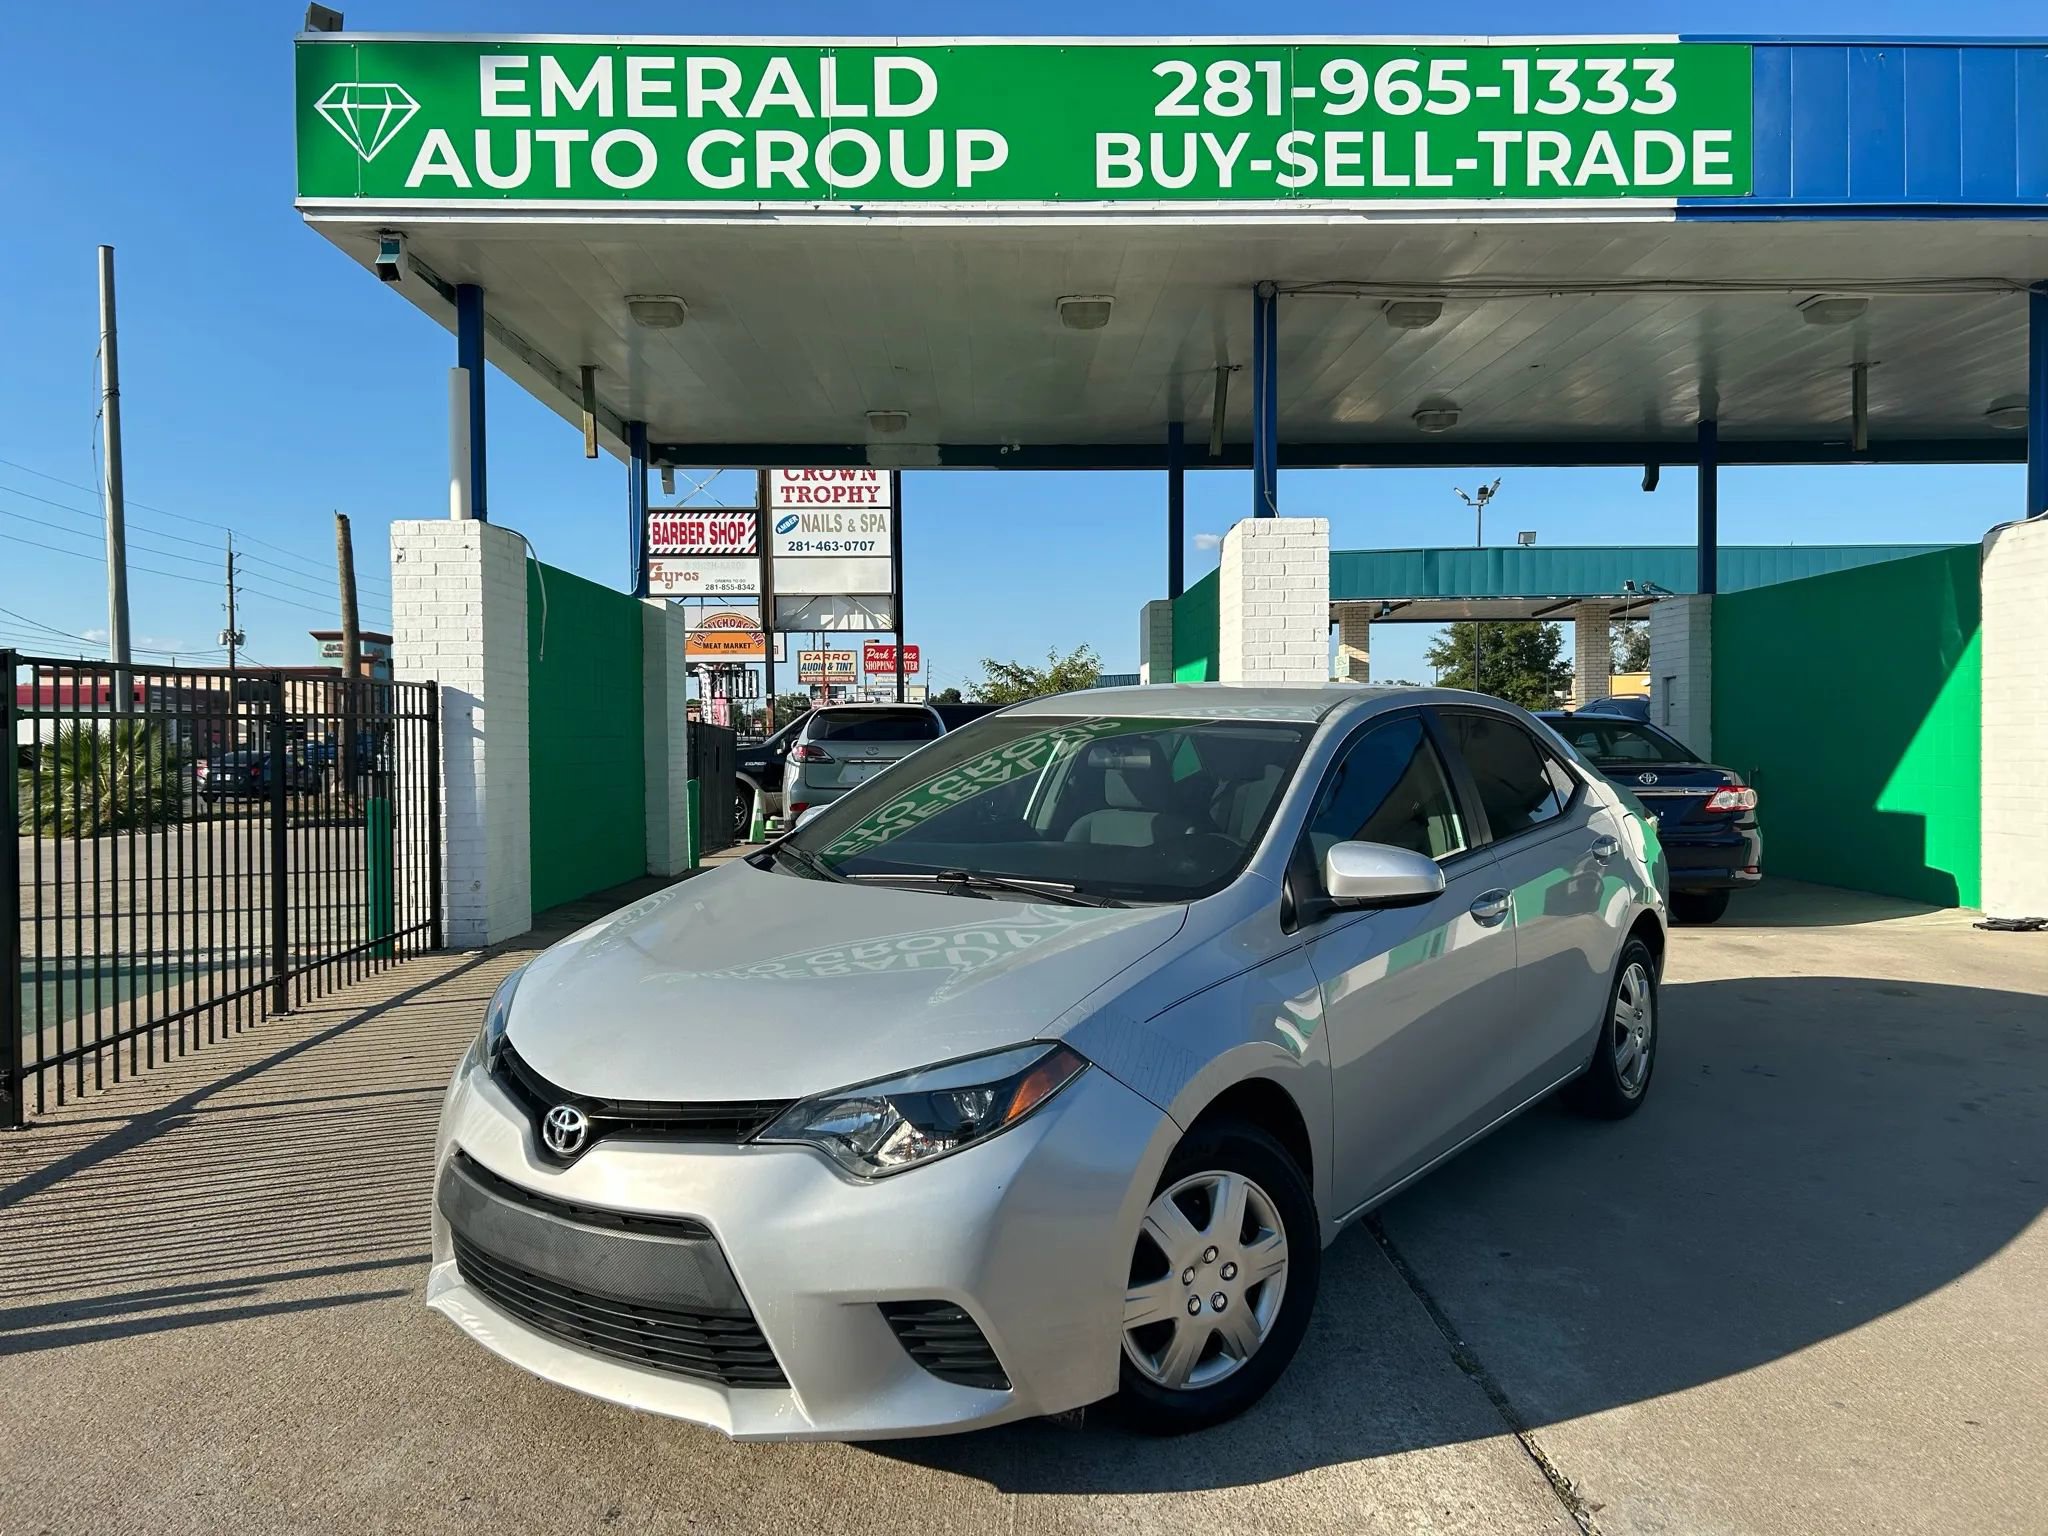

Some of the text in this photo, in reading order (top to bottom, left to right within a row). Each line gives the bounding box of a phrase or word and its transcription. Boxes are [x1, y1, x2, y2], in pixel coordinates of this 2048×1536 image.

[480, 55, 938, 118] EMERALD
[1151, 58, 1677, 117] 281-965-1333
[405, 128, 1010, 189] AUTO GROUP
[1095, 130, 1733, 189] BUY-SELL-TRADE
[783, 468, 877, 481] CROWN
[781, 486, 880, 503] TROPHY
[777, 515, 799, 533] AMBER
[801, 513, 887, 533] NAILS & SPA
[652, 521, 746, 545] BARBER SHOP
[788, 541, 875, 551] 281-463-0707
[648, 562, 699, 589] Gyros
[803, 653, 850, 661] CARRO
[866, 648, 917, 660] Park Pace
[827, 662, 833, 671] &
[836, 662, 854, 671] TINT
[865, 660, 894, 671] SHOPPING
